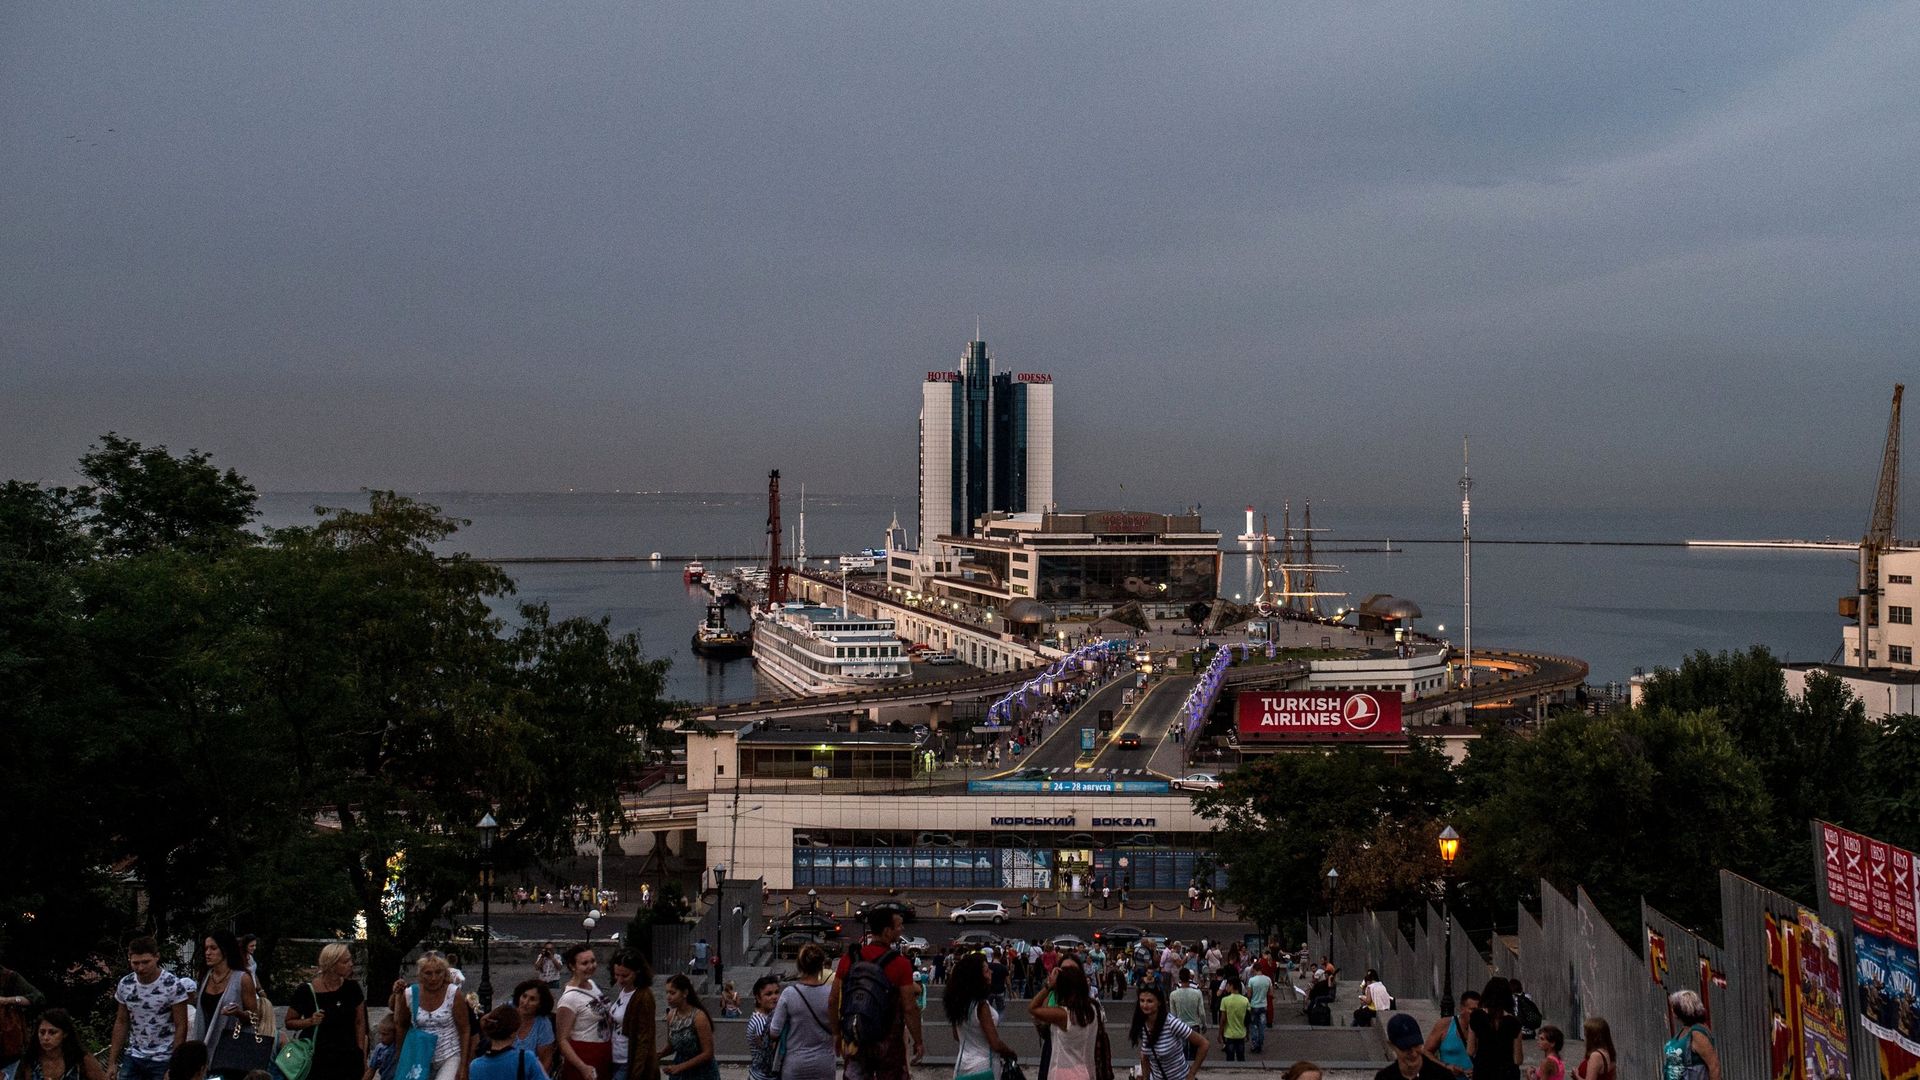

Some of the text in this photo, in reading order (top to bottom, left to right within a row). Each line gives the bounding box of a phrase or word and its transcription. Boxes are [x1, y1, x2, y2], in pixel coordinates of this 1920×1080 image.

[1017, 373, 1053, 381] ODESSA
[1261, 698, 1341, 711] TURKISH
[1261, 713, 1342, 726] AIRLINES
[1054, 782, 1063, 791] 24
[1071, 782, 1081, 791] 28
[1082, 783, 1112, 792] августа
[990, 815, 1156, 827] МОРСЬКИЙ ВОКЗАЛ
